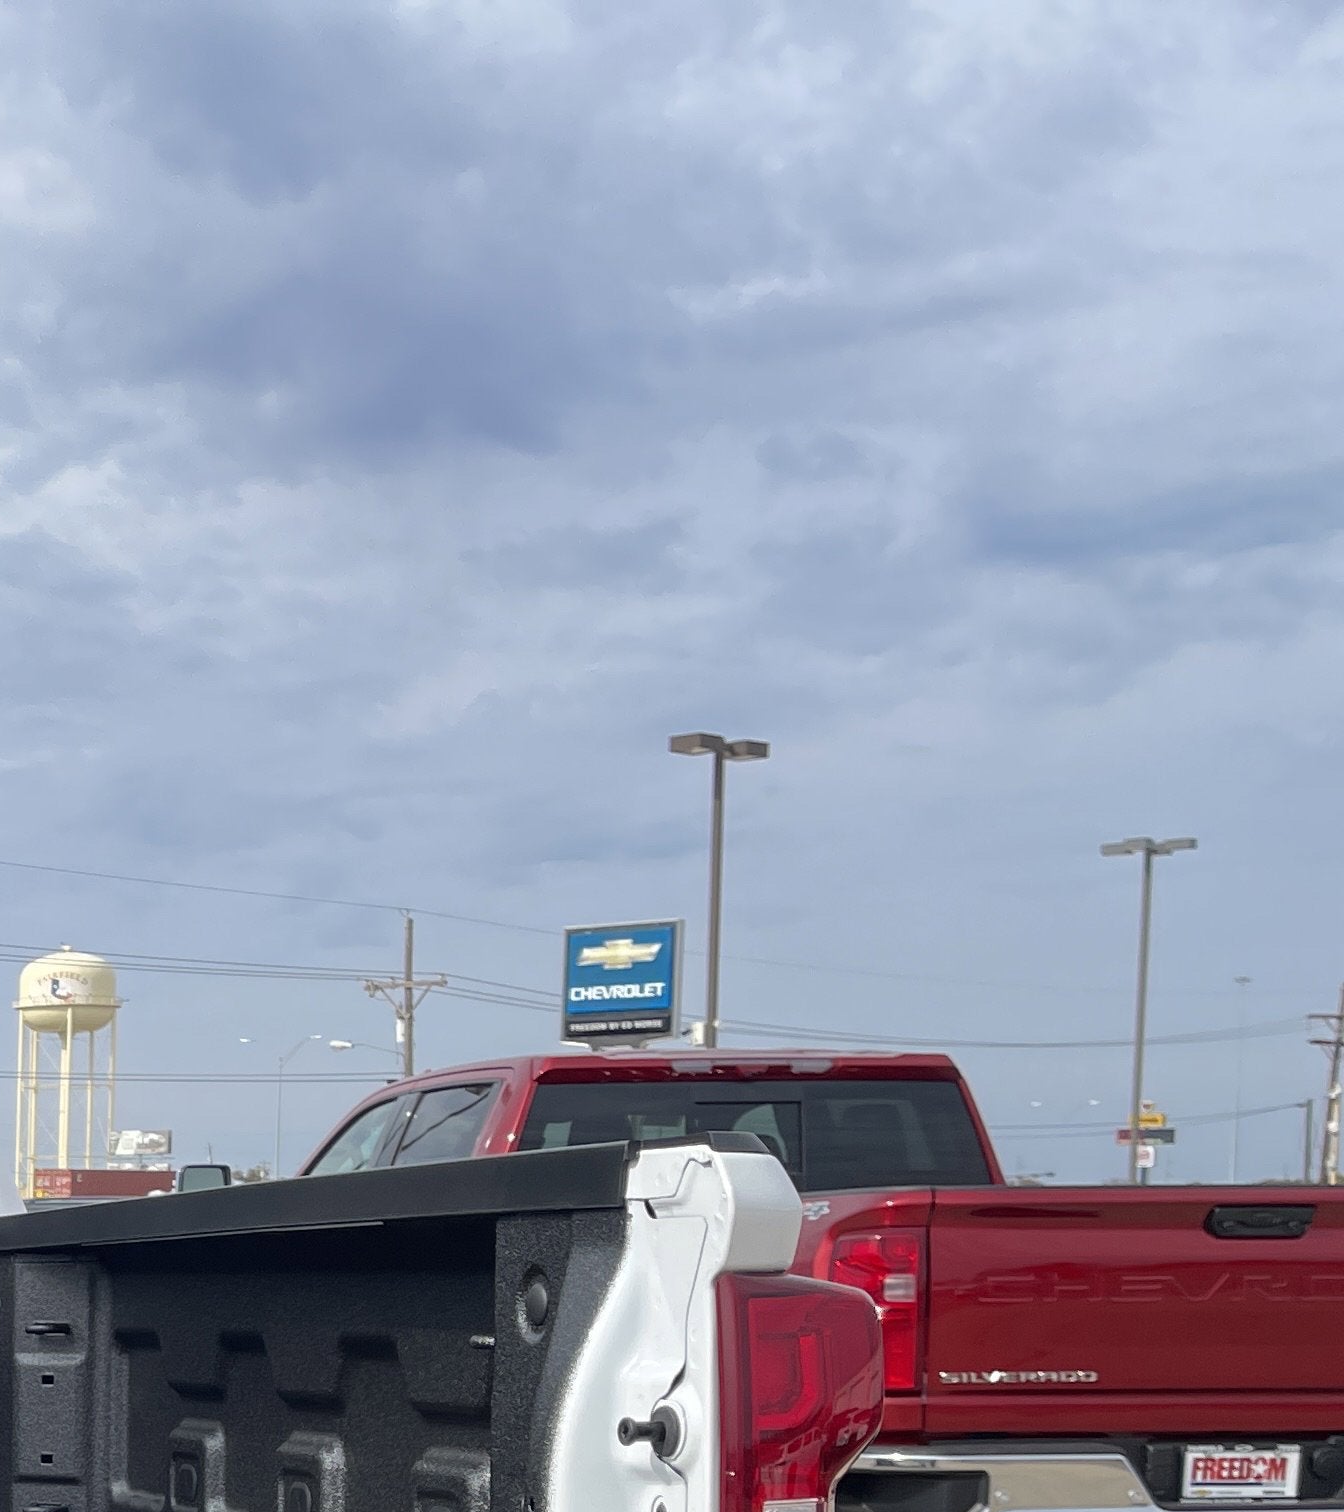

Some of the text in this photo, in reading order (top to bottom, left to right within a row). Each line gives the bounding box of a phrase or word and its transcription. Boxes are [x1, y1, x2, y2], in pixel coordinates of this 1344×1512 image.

[570, 982, 666, 1002] CHEVROLET
[939, 1370, 1099, 1384] SILVERADO
[1192, 1457, 1289, 1480] FREEDOM
